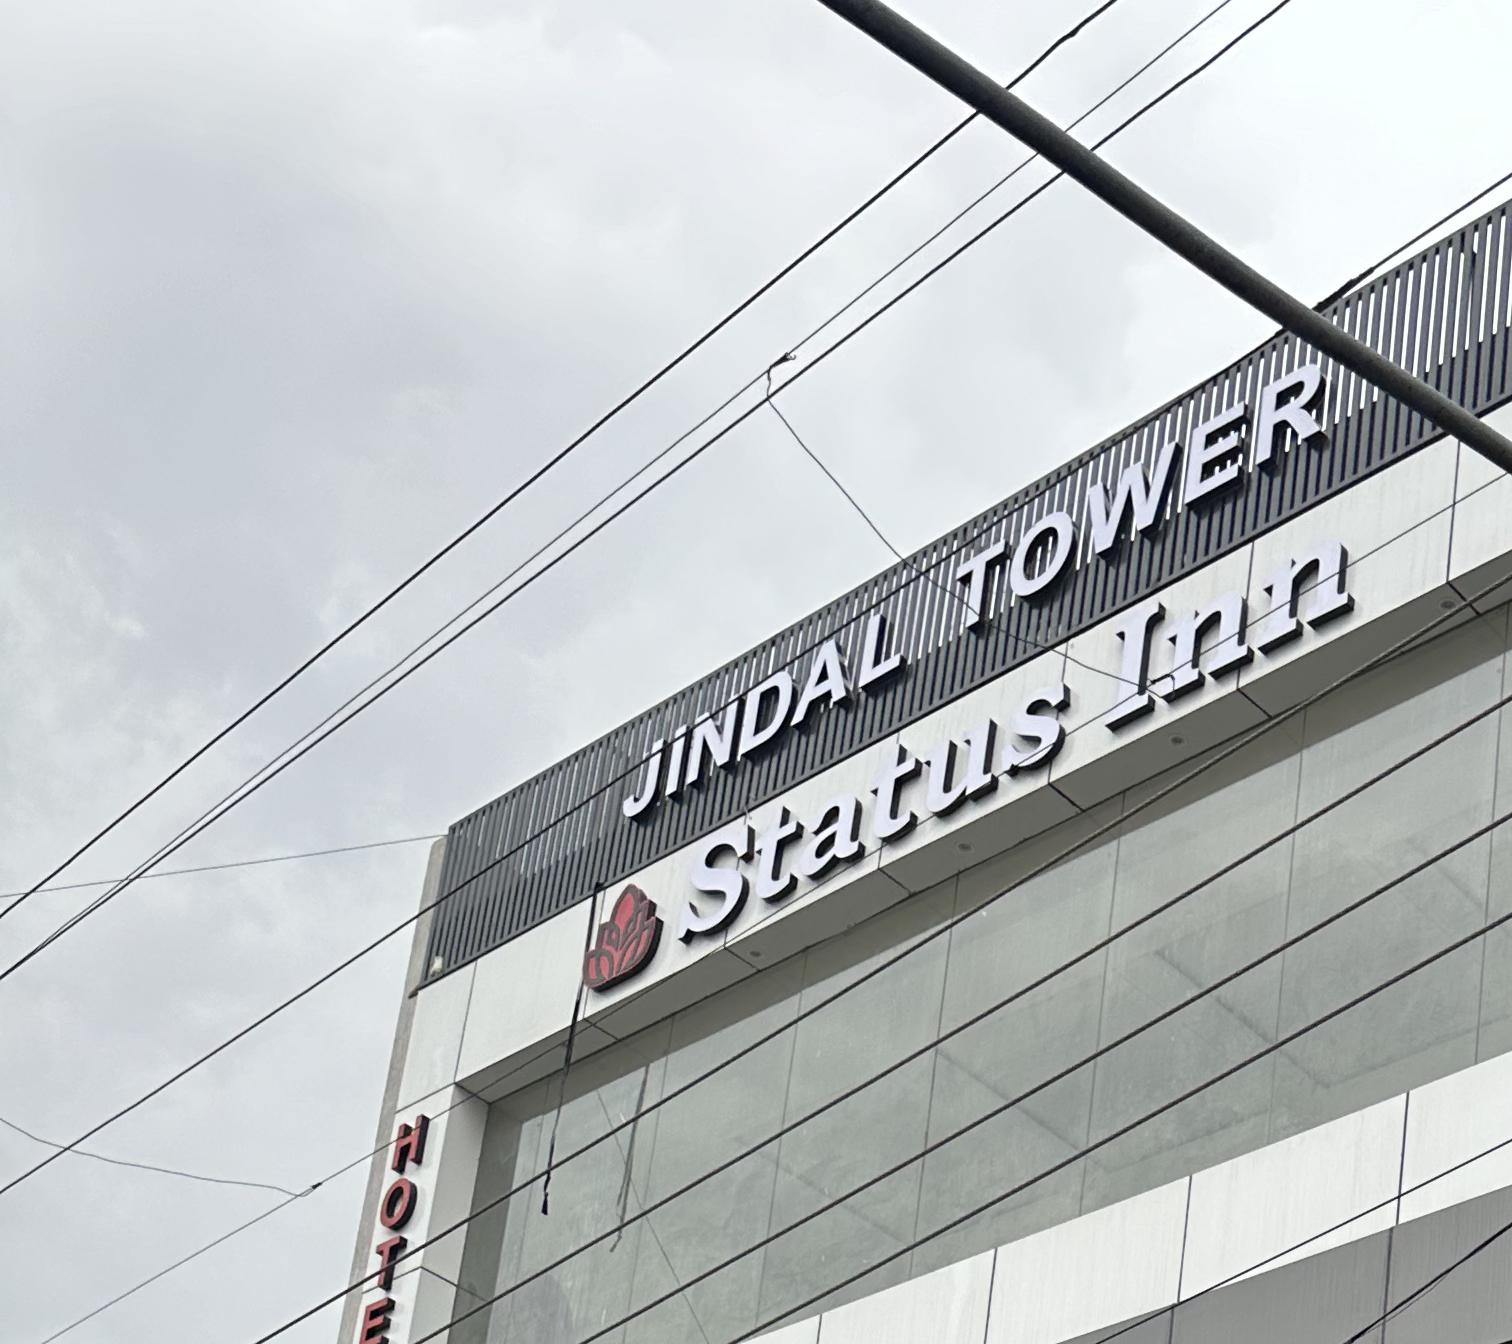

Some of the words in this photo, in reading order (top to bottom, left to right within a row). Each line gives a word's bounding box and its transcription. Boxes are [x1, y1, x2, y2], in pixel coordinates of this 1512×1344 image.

[623, 616, 909, 823] JINDAL
[957, 363, 1327, 631] TOWER
[678, 682, 1071, 944] Status
[1105, 538, 1355, 732] Inn
